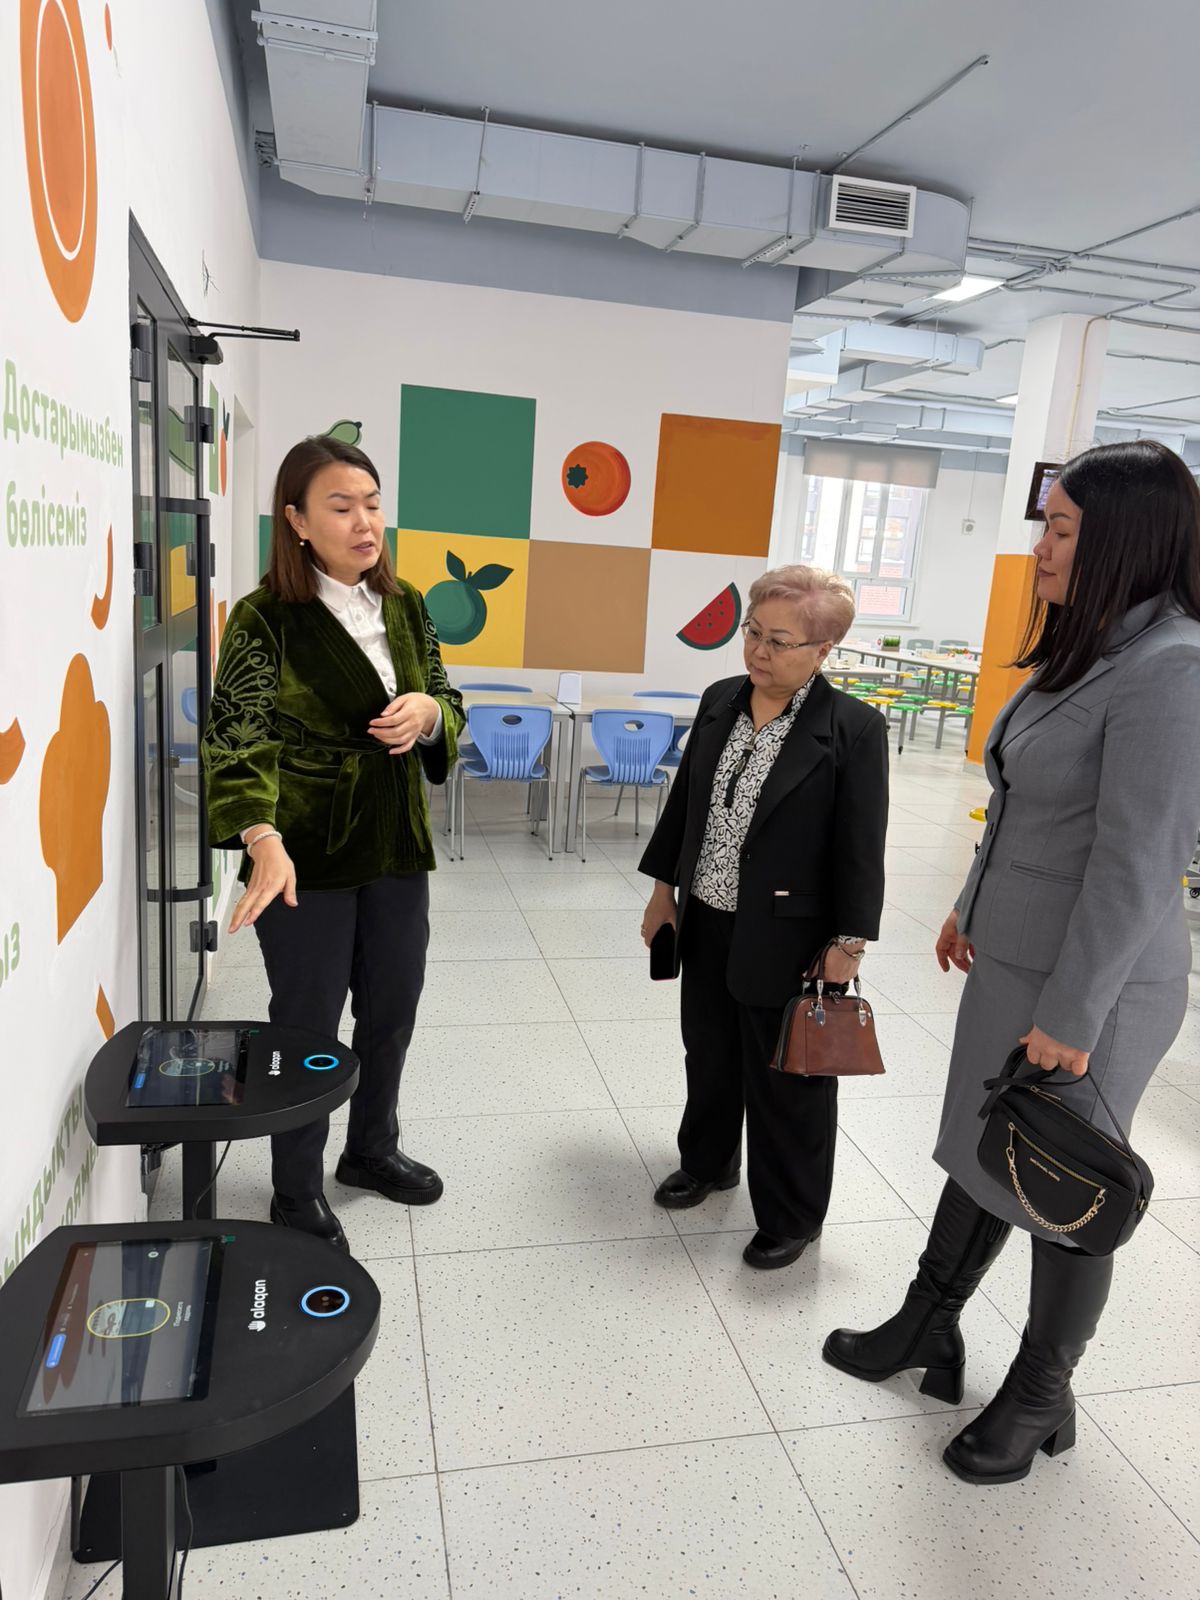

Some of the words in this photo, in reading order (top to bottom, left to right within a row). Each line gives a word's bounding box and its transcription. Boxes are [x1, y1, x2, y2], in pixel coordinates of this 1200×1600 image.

[3, 358, 124, 468] Достарымызбен
[6, 480, 87, 548] бөлісеміз
[250, 1279, 269, 1319] alaqan
